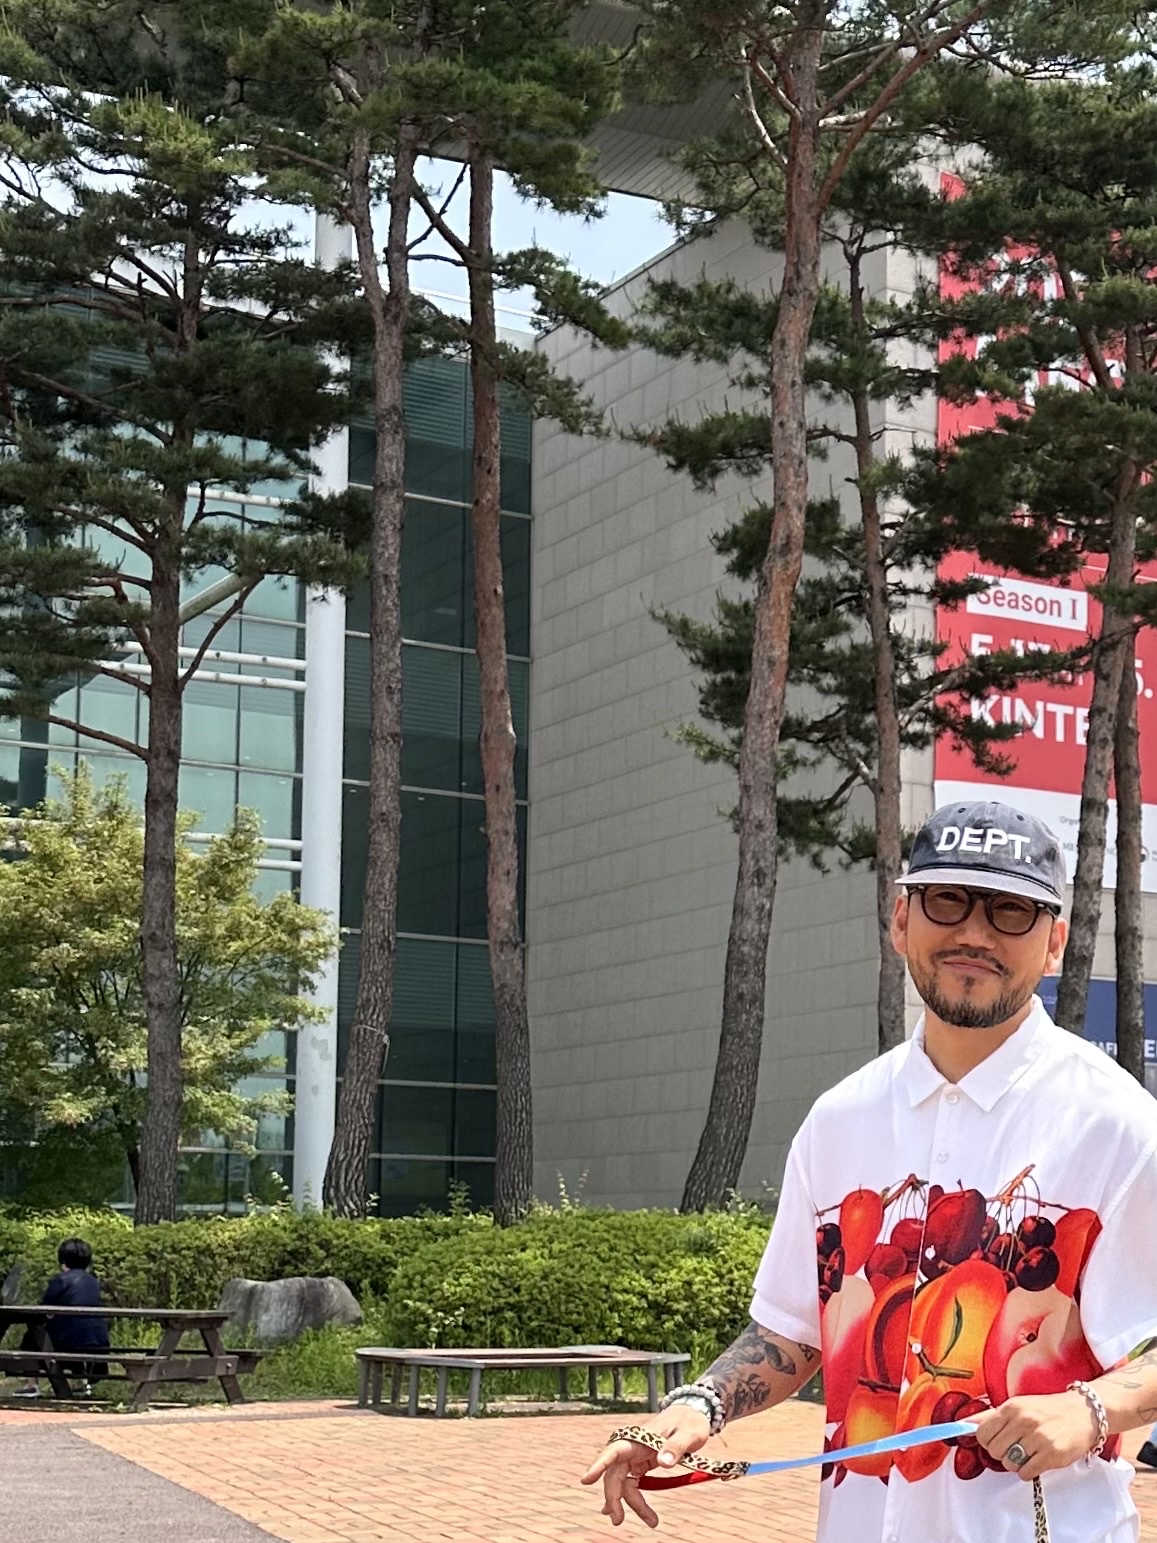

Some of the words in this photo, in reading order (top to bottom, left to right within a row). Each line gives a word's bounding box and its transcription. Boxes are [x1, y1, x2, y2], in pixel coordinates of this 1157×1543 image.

[976, 589, 1062, 618] Season
[970, 694, 1091, 745] KINTE
[936, 826, 1032, 864] DEPT.
